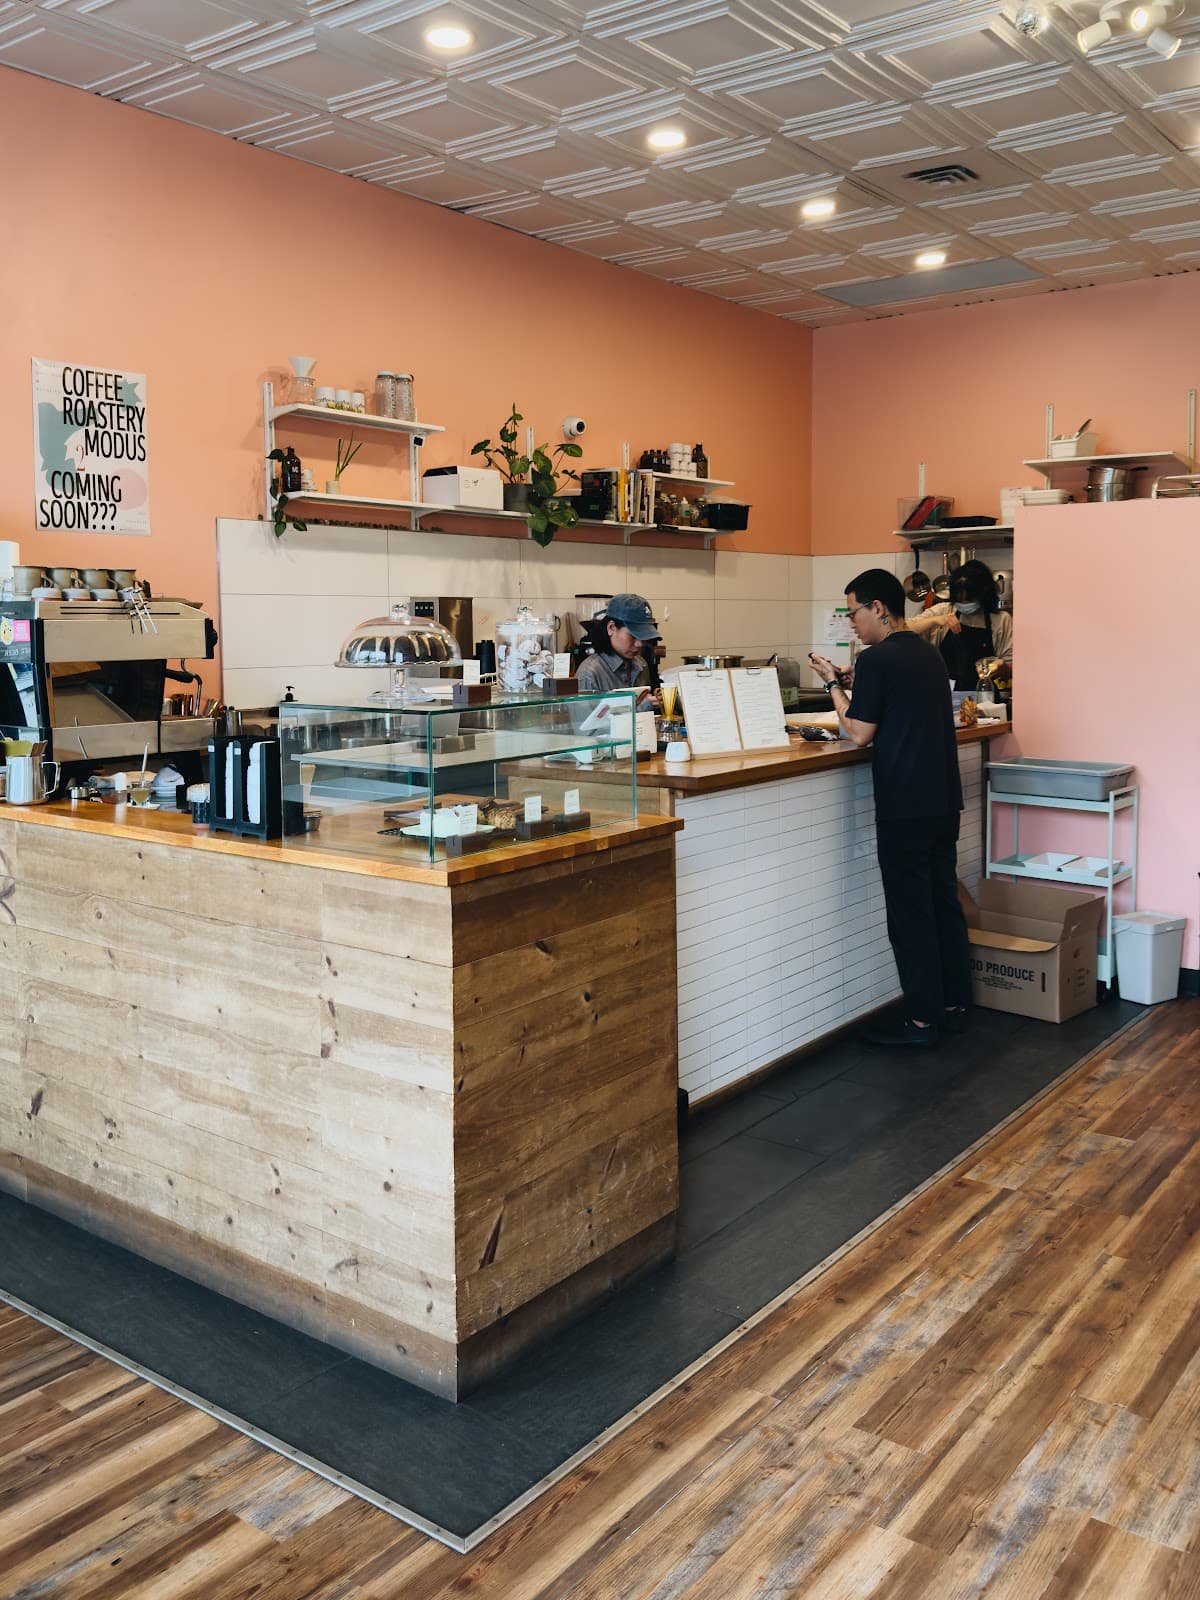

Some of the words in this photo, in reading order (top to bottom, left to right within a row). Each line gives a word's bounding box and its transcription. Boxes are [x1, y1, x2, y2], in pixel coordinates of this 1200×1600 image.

[62, 366, 124, 402] COFFEE
[63, 397, 146, 433] ROASTERY
[85, 429, 146, 462] MODUS
[51, 470, 122, 502] COMING
[40, 499, 117, 531] SOON???
[986, 962, 1035, 982] PRODUCE
